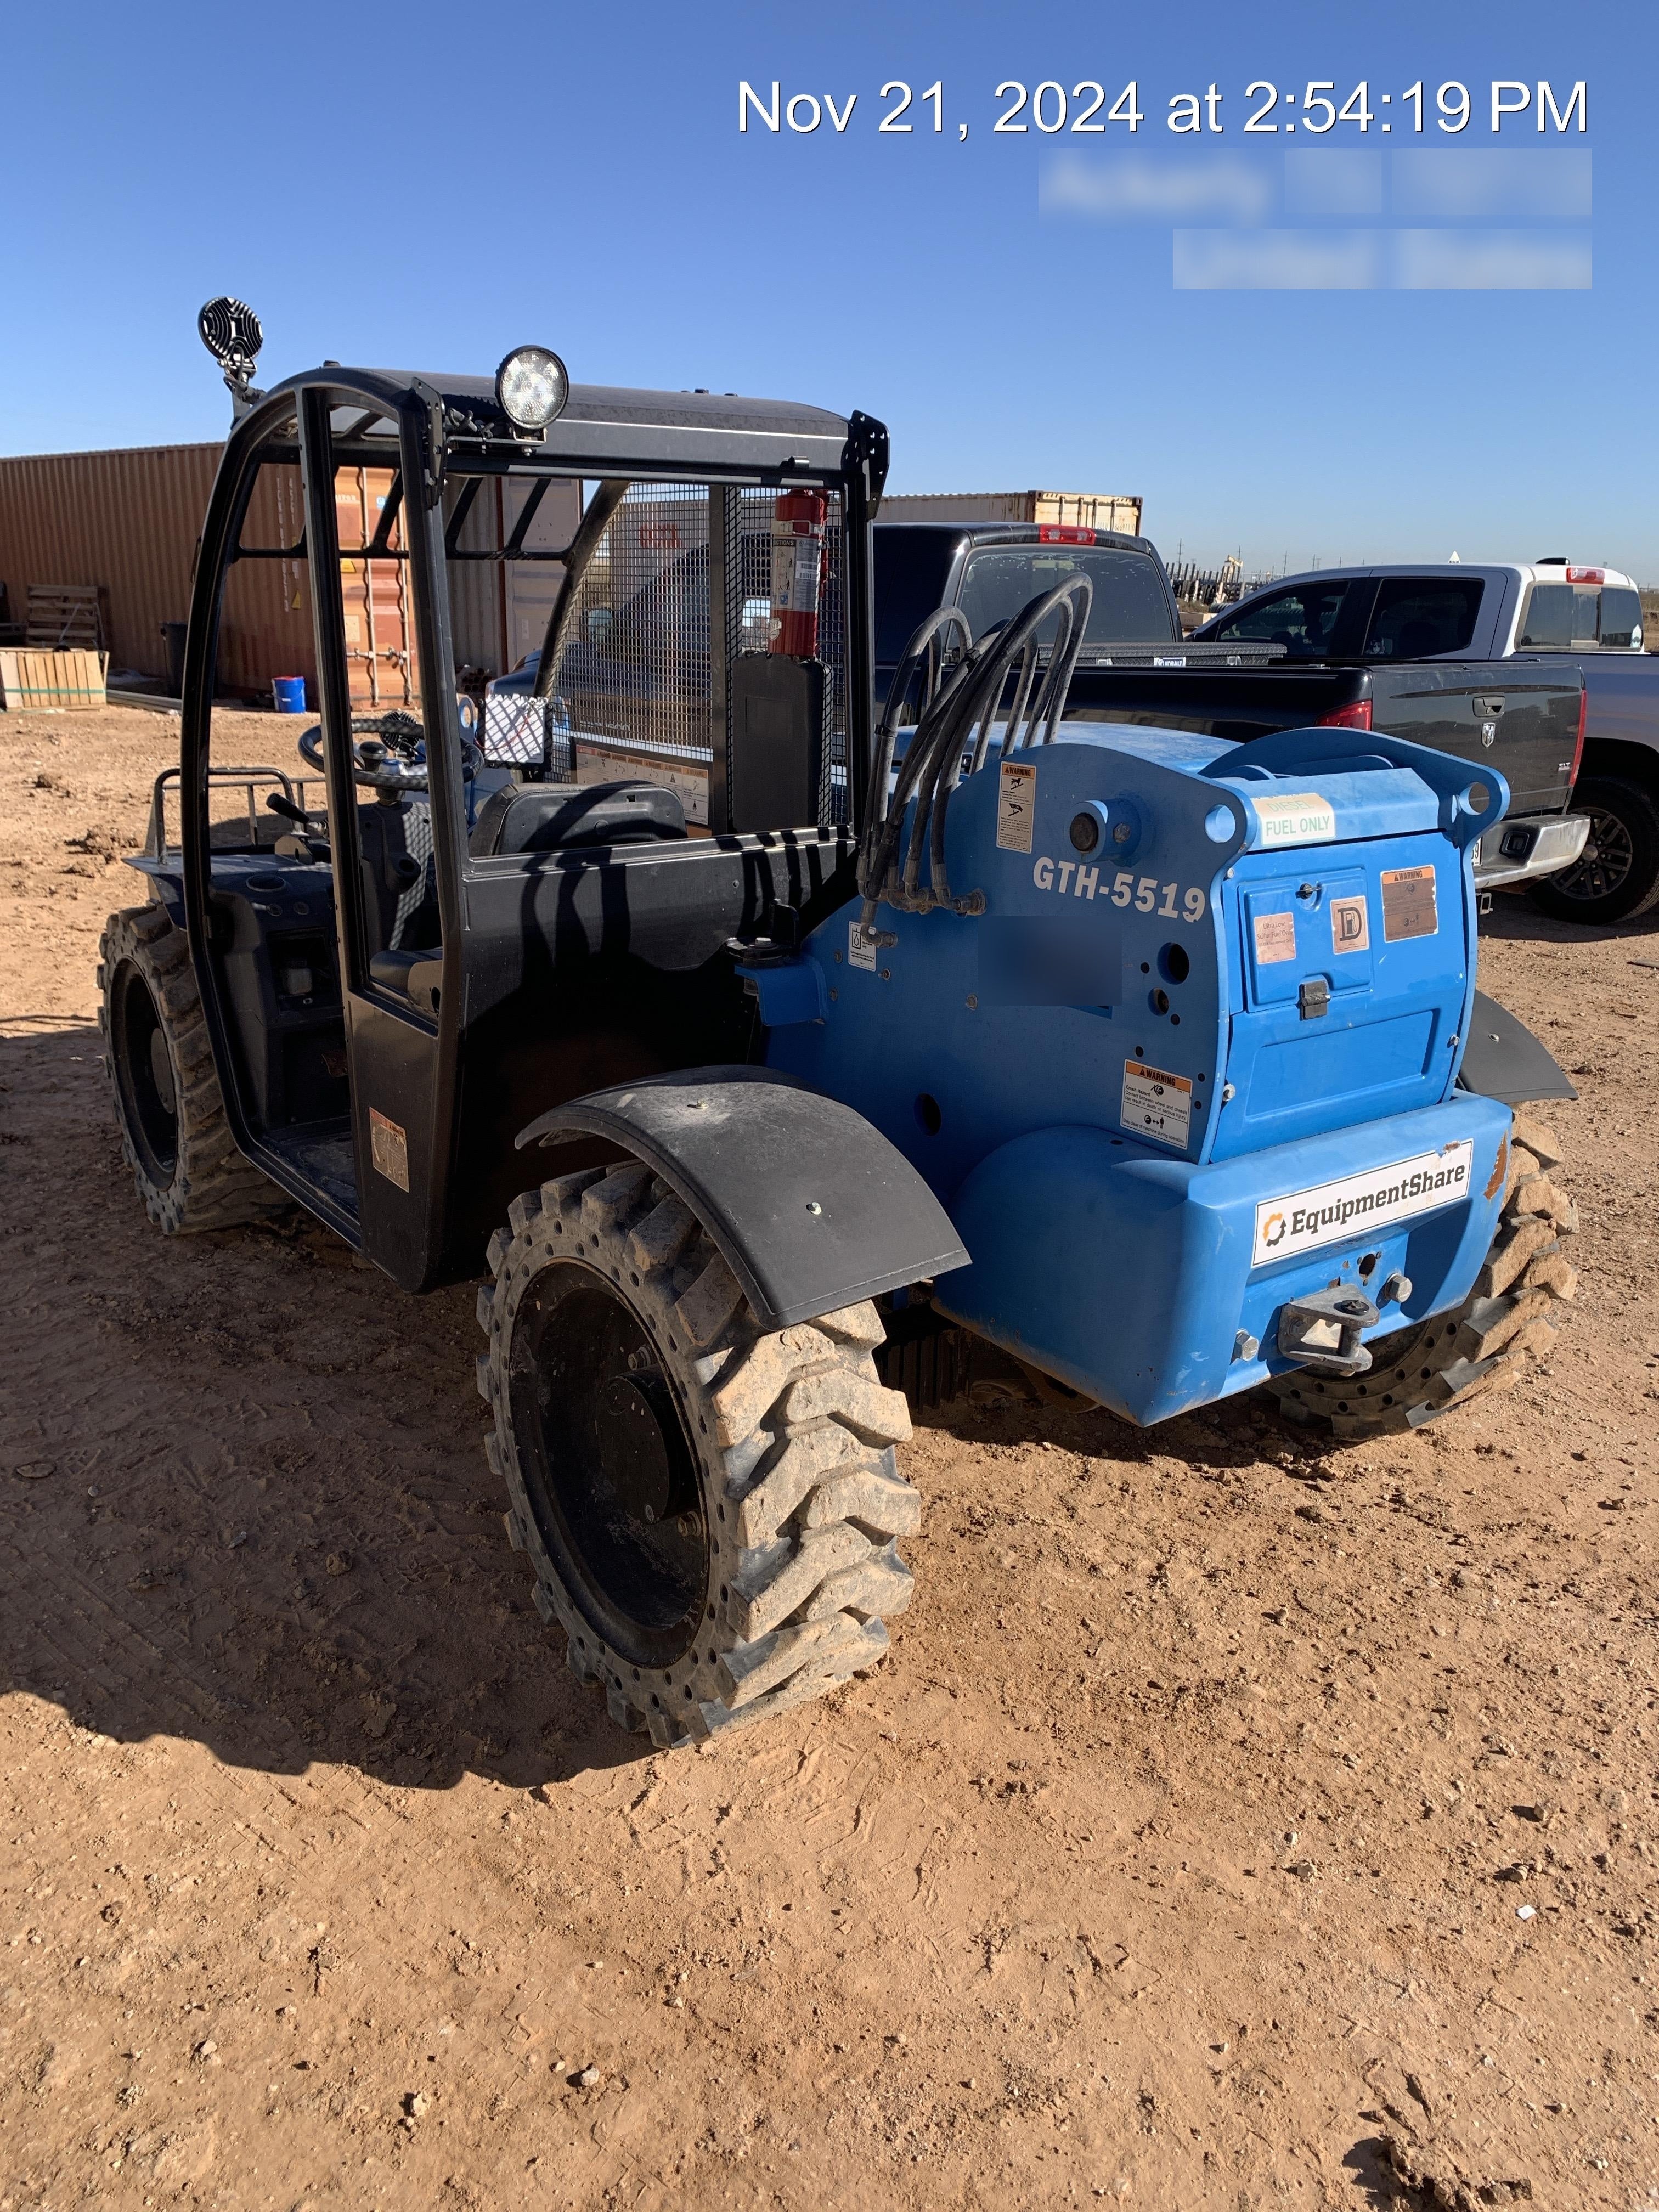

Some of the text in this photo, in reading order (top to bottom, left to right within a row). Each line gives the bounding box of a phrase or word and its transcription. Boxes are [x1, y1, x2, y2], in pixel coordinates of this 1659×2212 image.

[1009, 766, 1031, 777] WARNING
[1266, 800, 1315, 812] DIESEL
[1266, 815, 1330, 836] FUEL ONLY
[1398, 870, 1423, 881] WARNING
[1033, 856, 1206, 923] GTH-5519
[1337, 906, 1362, 941] D
[1146, 1069, 1176, 1086] WARNING
[1125, 1090, 1138, 1098] Contact
[1139, 1094, 1154, 1103] between
[1137, 1088, 1150, 1097] Hazard
[1290, 1164, 1466, 1235] EquipmentShare
